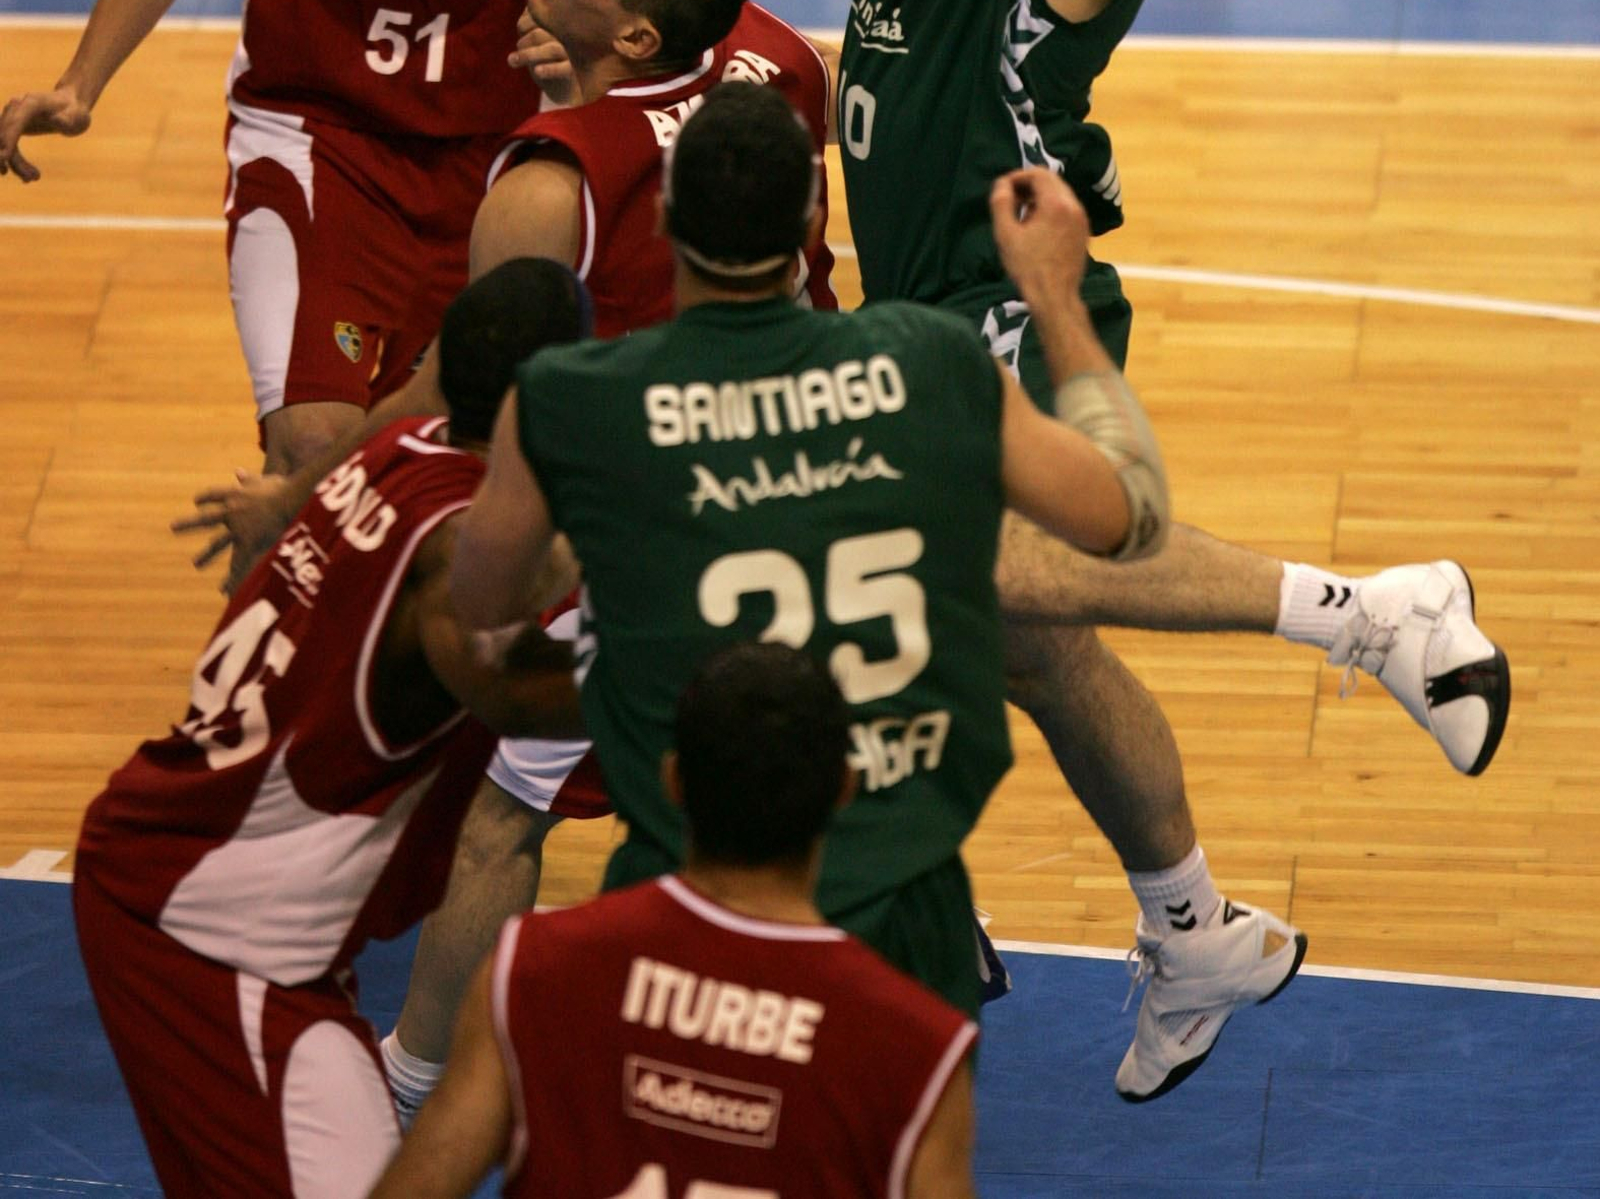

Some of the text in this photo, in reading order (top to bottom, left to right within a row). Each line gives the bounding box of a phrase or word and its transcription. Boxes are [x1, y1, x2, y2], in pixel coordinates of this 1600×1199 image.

[365, 8, 450, 82] 51
[644, 354, 907, 446] SANTIAGO
[181, 598, 297, 771] 45
[847, 709, 951, 792] AGA
[621, 956, 826, 1064] ITURBE
[635, 1072, 773, 1133] Adecco
